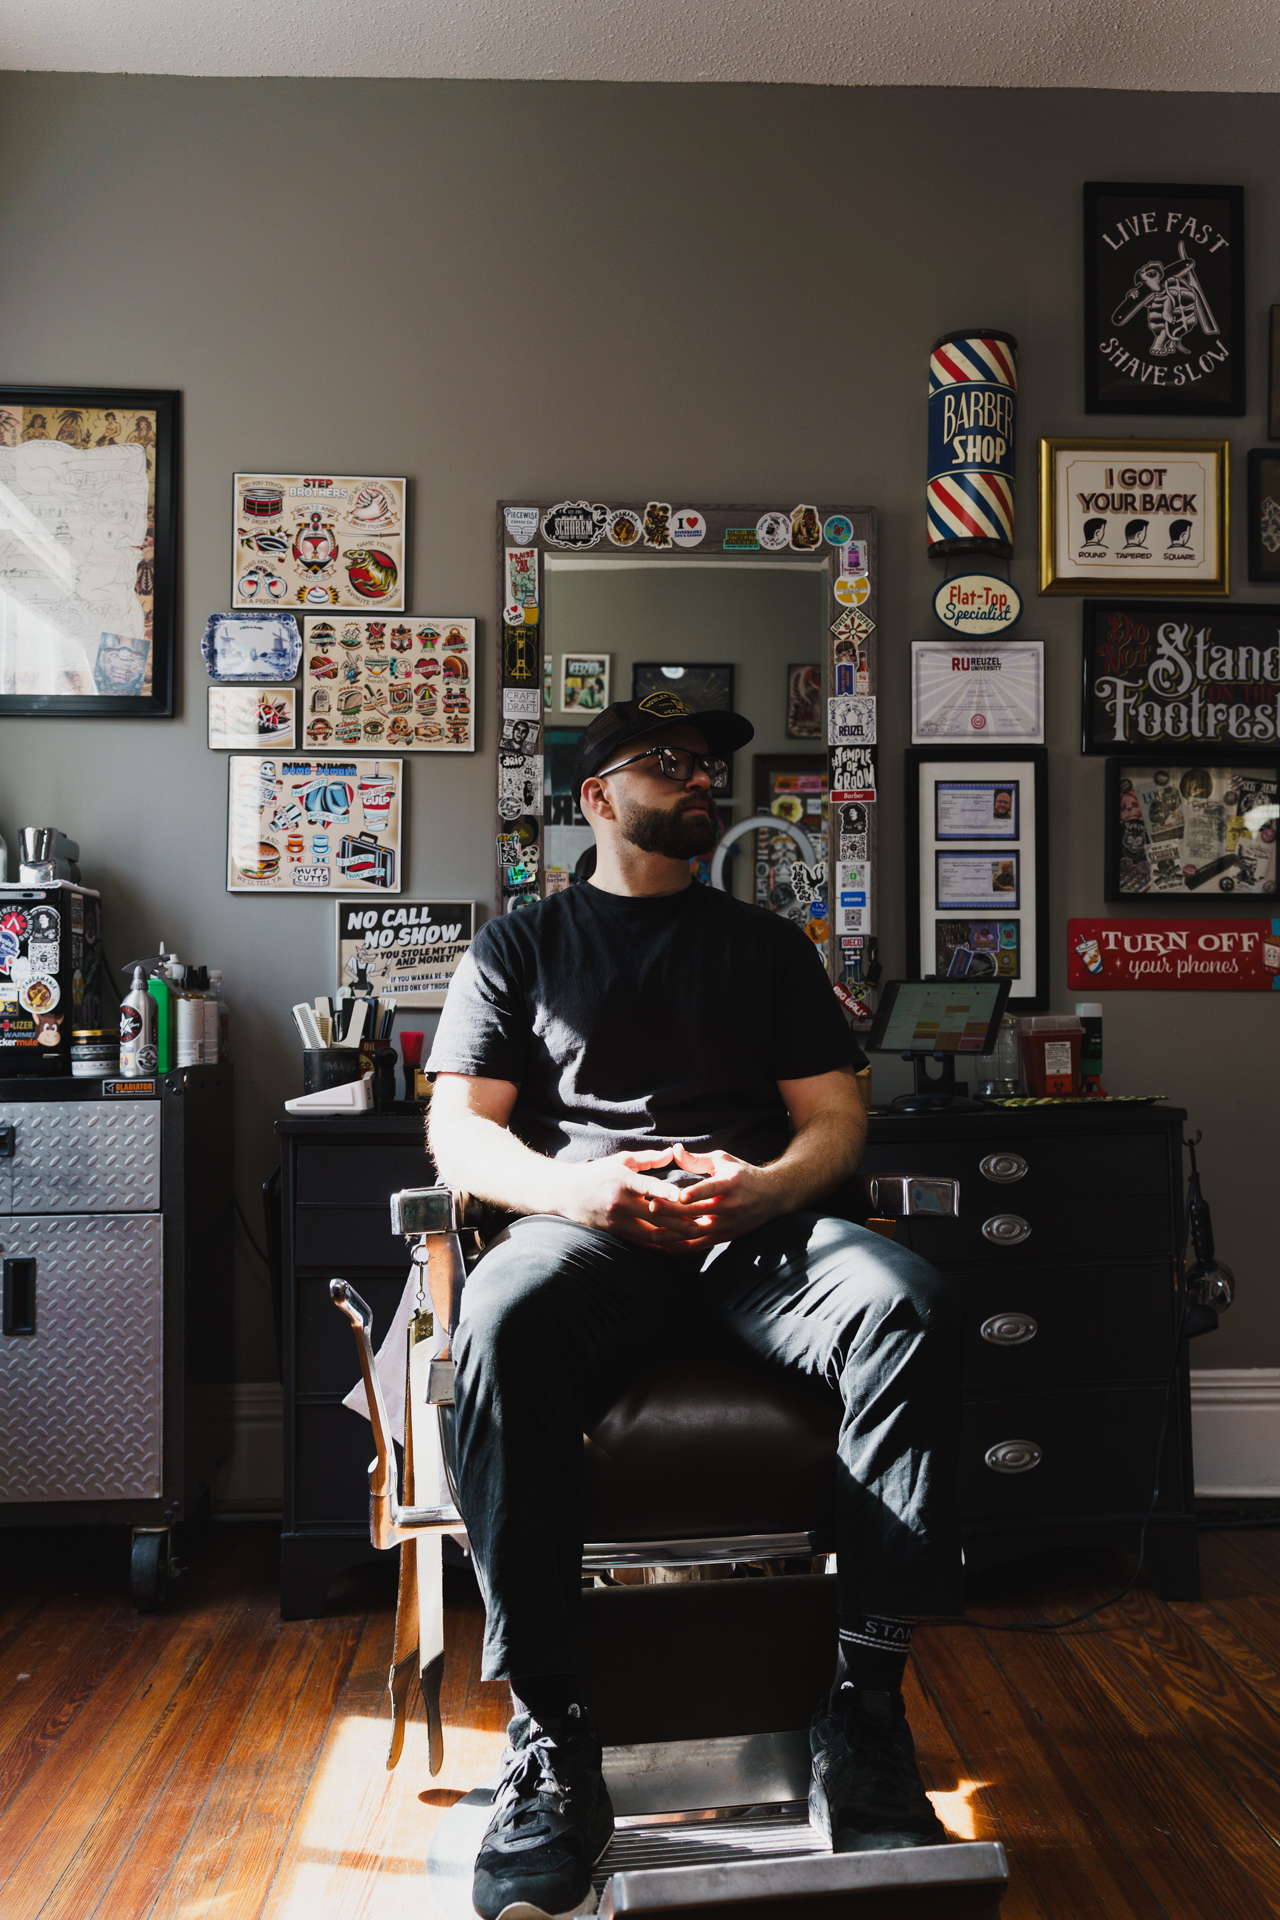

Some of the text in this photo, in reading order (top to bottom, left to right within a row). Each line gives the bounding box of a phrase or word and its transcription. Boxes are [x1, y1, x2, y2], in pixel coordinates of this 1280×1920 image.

[1102, 212, 1229, 253] LIVE FAST
[1100, 338, 1229, 386] SHAVE SLOW
[944, 391, 1013, 447] BARBER
[952, 435, 1006, 464] SHOP
[265, 481, 284, 489] TOUCH
[302, 478, 333, 488] STEP
[1119, 468, 1167, 489] GOT
[288, 487, 348, 499] BROTHERS
[352, 486, 360, 494] WE
[379, 483, 396, 506] BECOME
[321, 506, 336, 514] AND
[1078, 493, 1198, 514] YOUR BACK
[270, 516, 284, 524] SET?
[504, 508, 538, 520] PIECEWISE
[352, 520, 368, 528] BEST
[554, 520, 593, 536] SCHOREM
[678, 518, 684, 529] I
[376, 541, 393, 552] YOUR
[509, 550, 534, 562] PRAISE
[1115, 552, 1152, 560] TAPERED
[243, 559, 278, 572] THIS HOUSE
[306, 572, 326, 580] HOES
[344, 584, 400, 606] FAVORITE DINOSAUR
[950, 584, 1008, 612] Flat-Top
[509, 613, 523, 622] PORK
[832, 606, 874, 632] LOVELAND COFFEE
[944, 602, 1012, 626] Specialist
[1107, 612, 1148, 644] Do
[952, 658, 970, 671] RU
[971, 657, 1002, 665] REUZEL
[1148, 622, 1280, 697] Stand
[507, 692, 536, 700] CRAFT
[1208, 686, 1276, 703] ON THE
[507, 703, 536, 711] DRAFT
[363, 716, 386, 724] DOWN
[839, 725, 865, 736] REUZEL
[832, 747, 872, 770] #TEMPLE
[282, 762, 312, 776] DUMB
[317, 763, 357, 776] DUMBER
[846, 761, 858, 775] OF
[834, 764, 876, 790] GROOM
[307, 780, 325, 792] MUST
[363, 797, 391, 805] GULP
[266, 837, 280, 846] AND
[348, 854, 370, 864] WAS
[236, 875, 255, 885] WE'LL
[272, 876, 282, 884] YA
[347, 906, 432, 930] NO CALL
[19, 910, 34, 942] BARBERS
[365, 923, 462, 949] NO SHOW
[842, 938, 862, 947] WECO
[1102, 932, 1259, 956] TURN OFF
[380, 951, 400, 959] YOU
[401, 948, 430, 958] STOLE
[432, 947, 446, 955] MY
[395, 954, 455, 967] AND MONEY!
[1129, 955, 1239, 980] your phones
[411, 973, 433, 981] WANNA
[833, 986, 847, 1001] BIG
[364, 1042, 375, 1051] OIL
